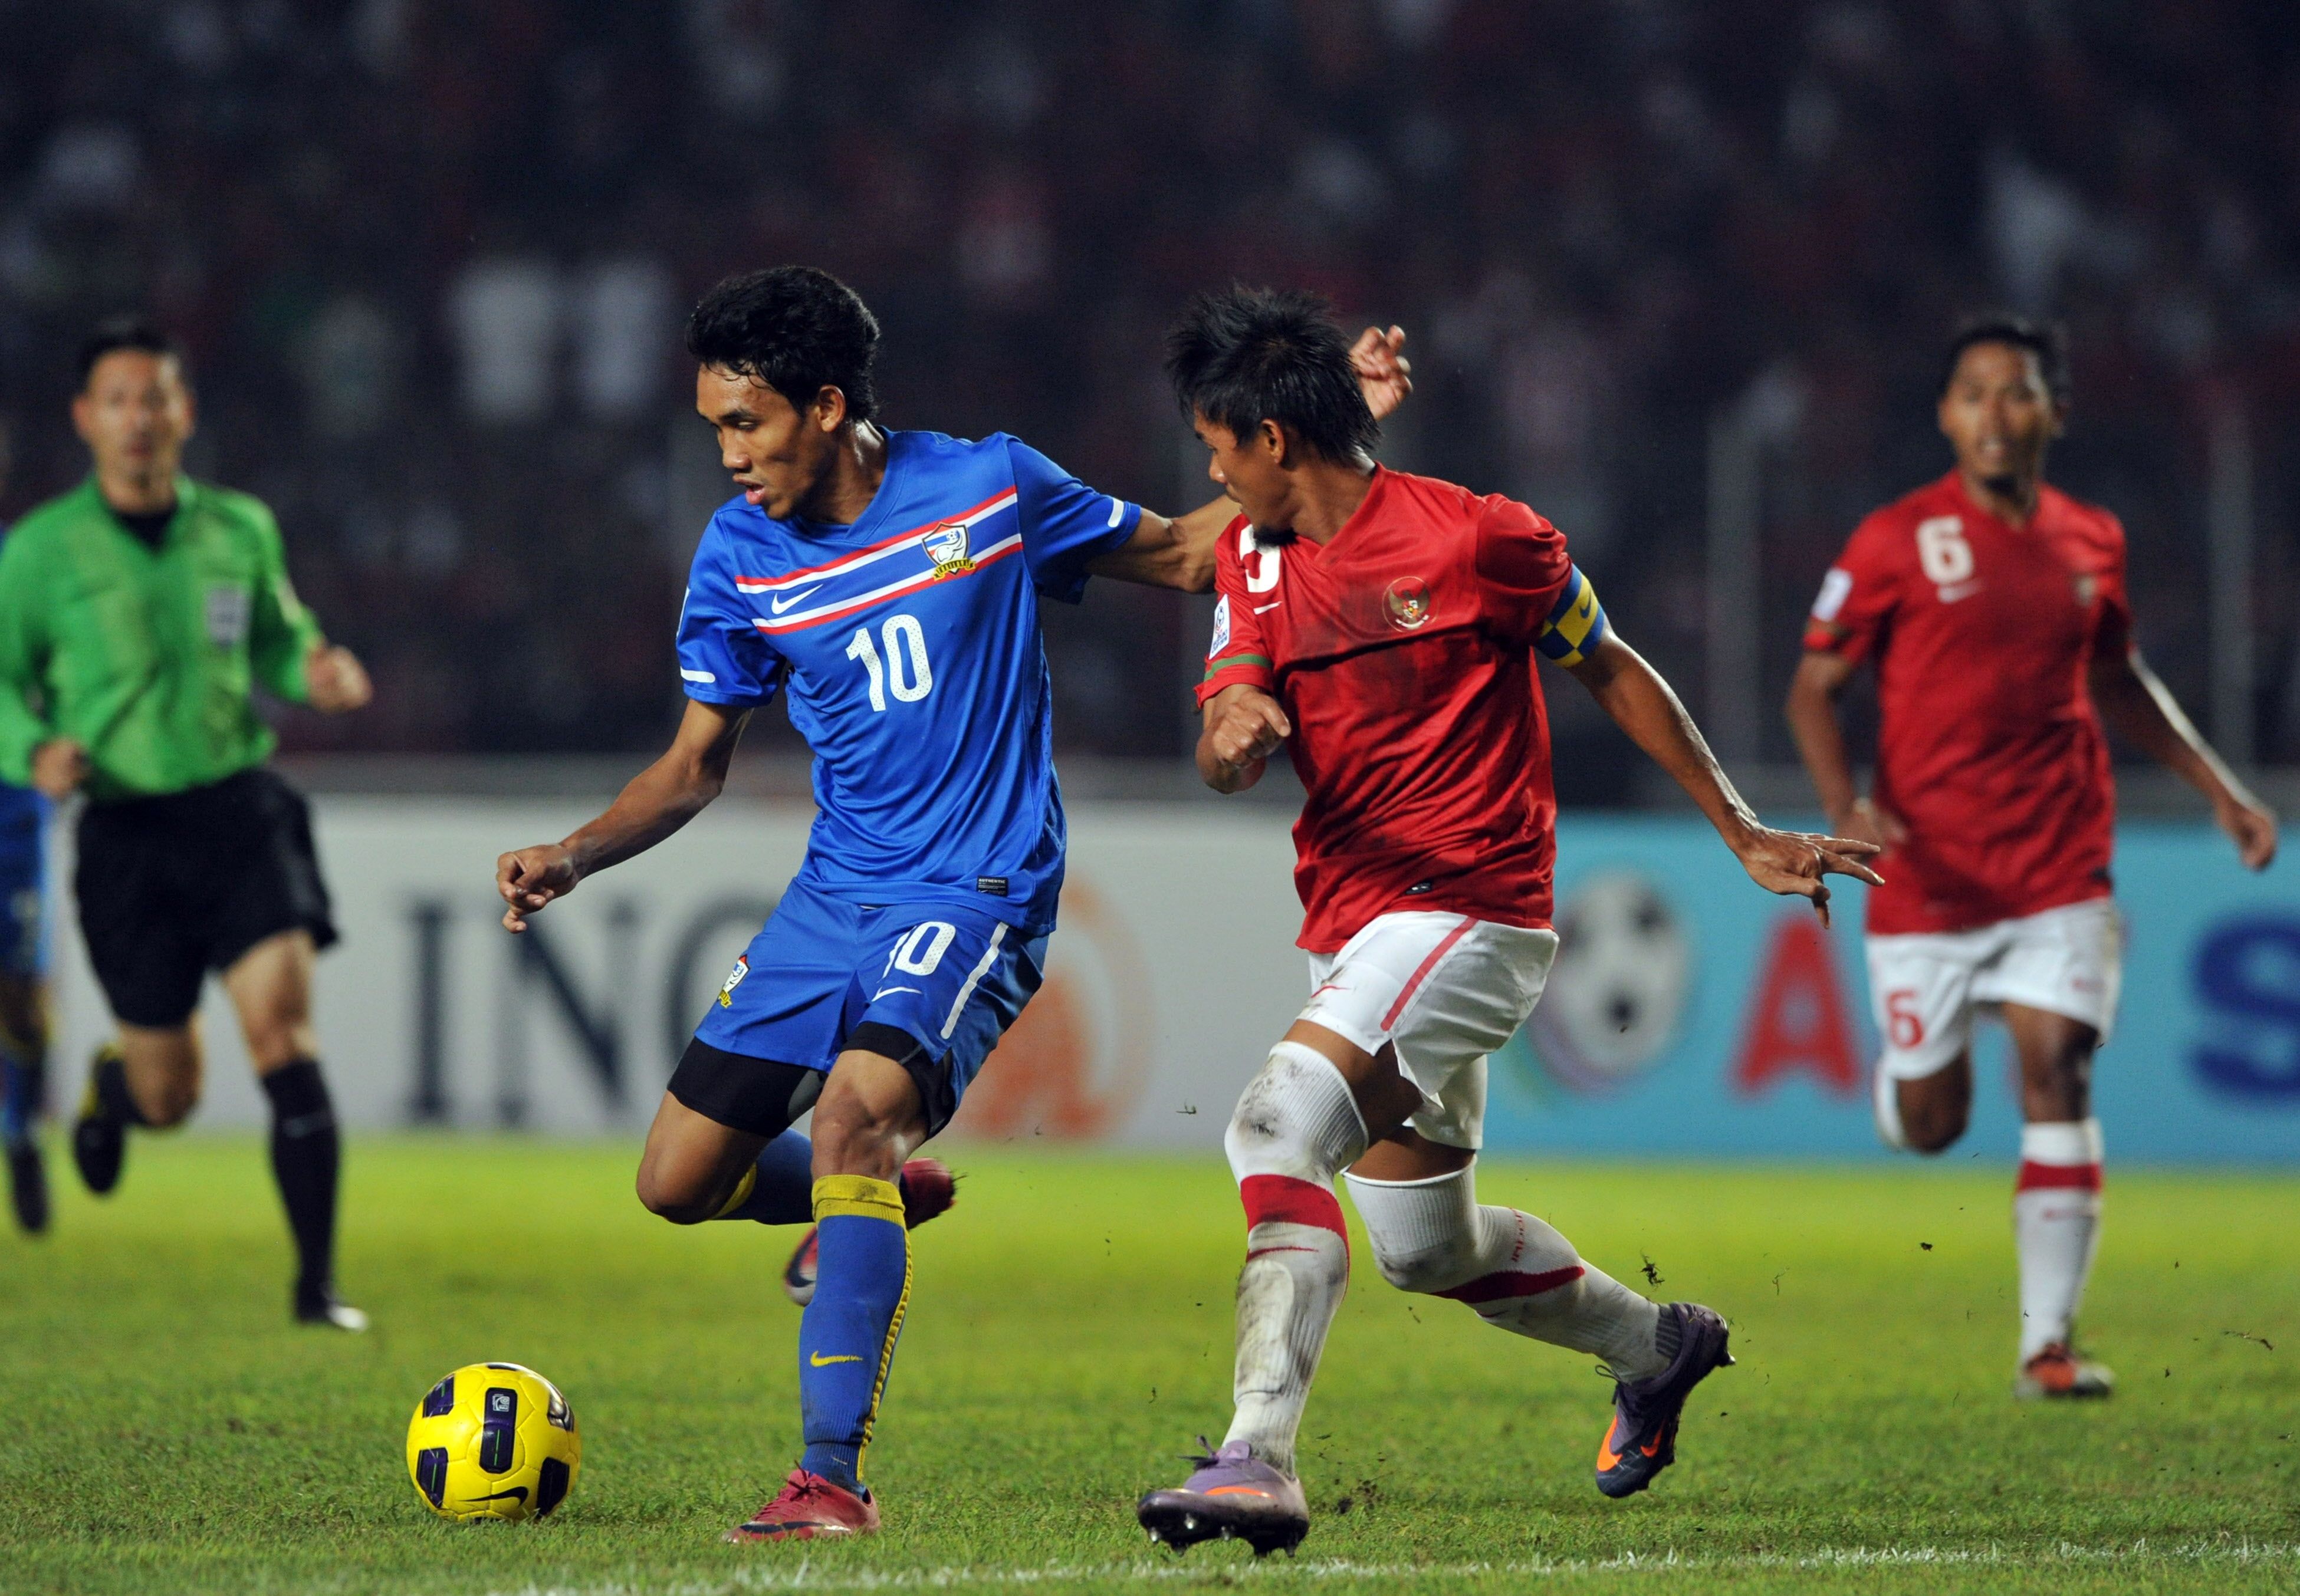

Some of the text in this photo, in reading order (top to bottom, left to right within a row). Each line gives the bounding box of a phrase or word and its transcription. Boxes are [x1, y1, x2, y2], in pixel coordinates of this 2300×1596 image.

[1917, 516, 1973, 583] 6
[845, 614, 932, 712] 10
[1887, 989, 1924, 1051] 6
